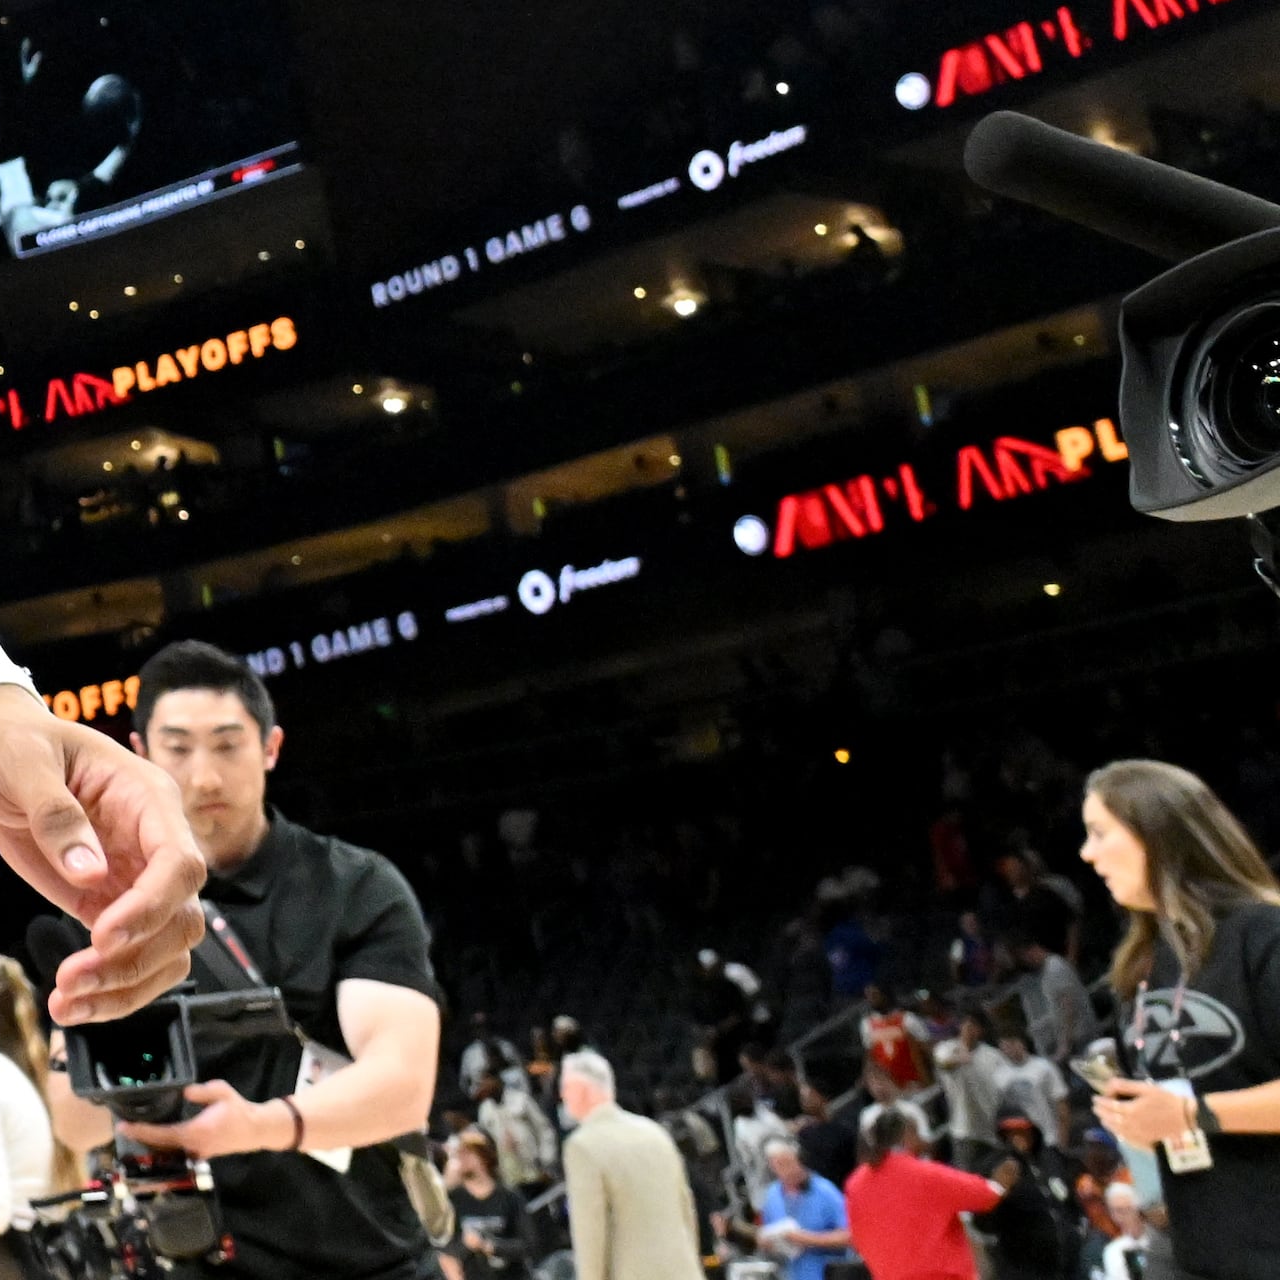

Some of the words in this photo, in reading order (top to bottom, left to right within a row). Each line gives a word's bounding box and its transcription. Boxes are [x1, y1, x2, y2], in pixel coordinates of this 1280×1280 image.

[370, 254, 460, 309] ROUND
[463, 246, 480, 272] 1
[484, 212, 568, 264] GAME
[111, 314, 299, 399] PLAYOFFS
[1055, 417, 1129, 473] PL
[245, 646, 287, 676] ND
[289, 640, 306, 669] 1
[310, 617, 392, 664] GAME
